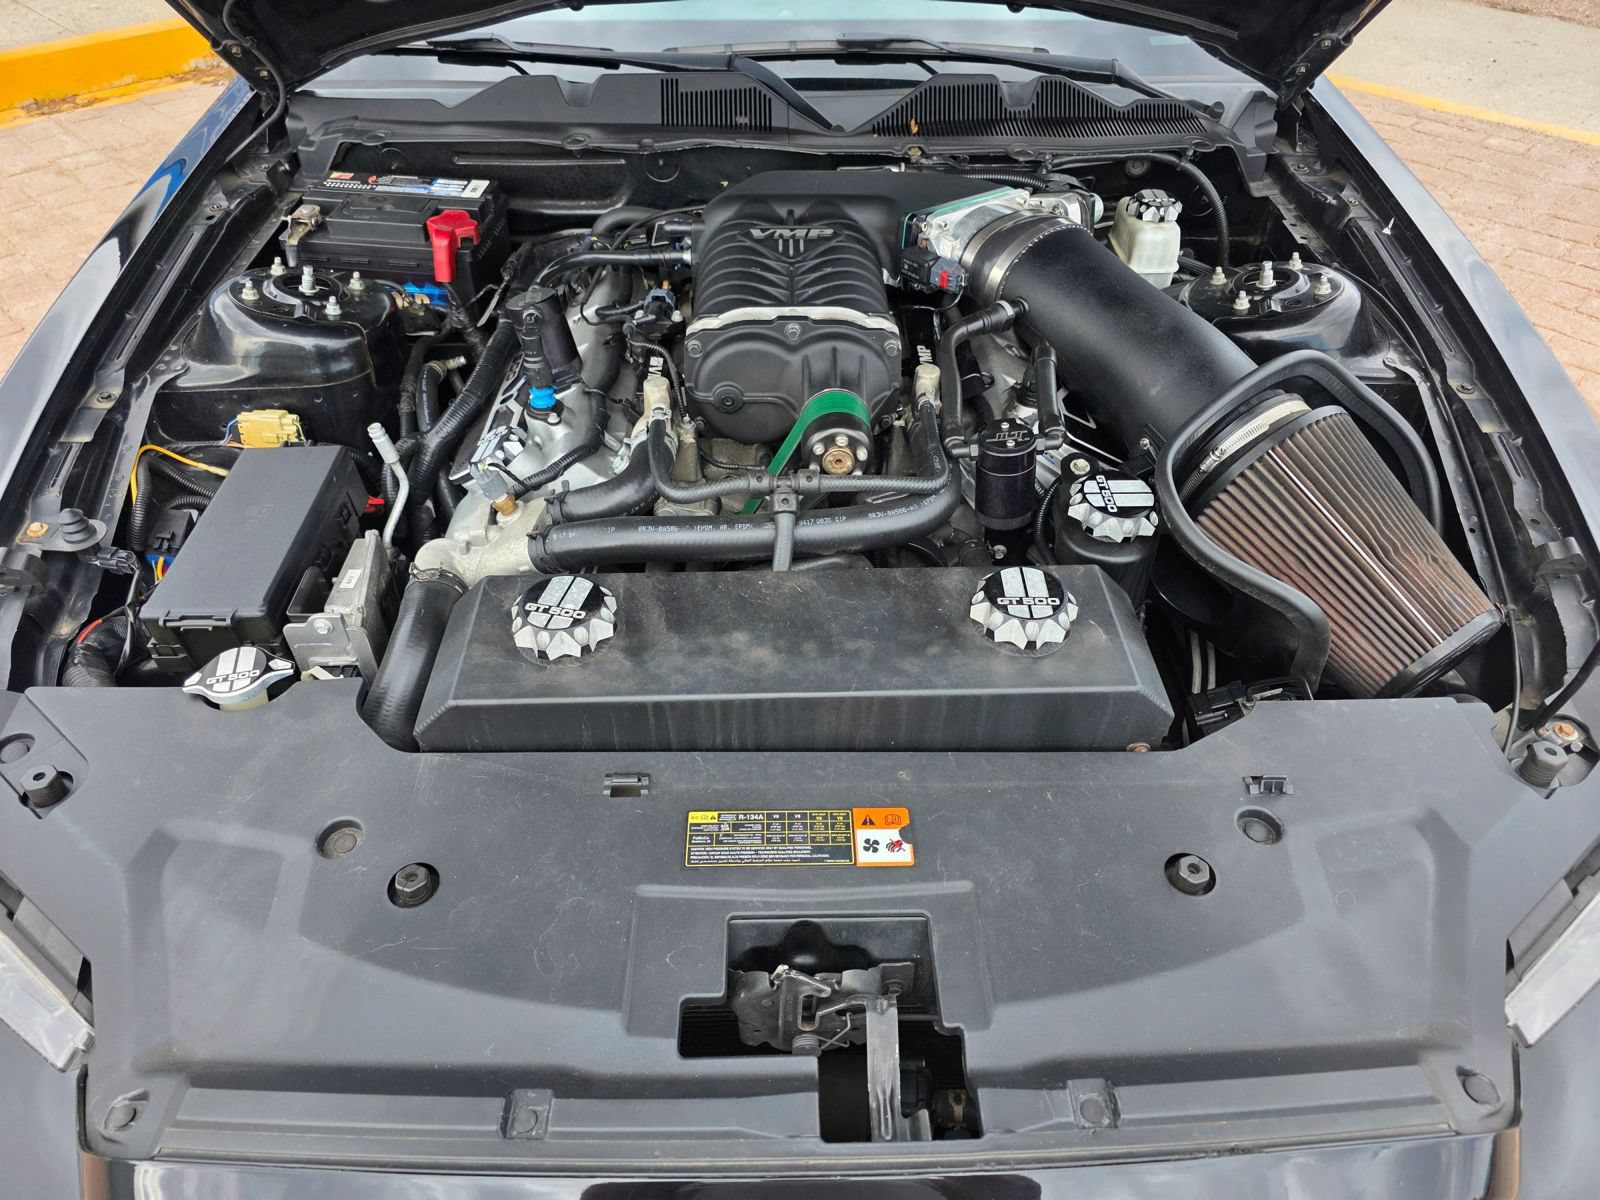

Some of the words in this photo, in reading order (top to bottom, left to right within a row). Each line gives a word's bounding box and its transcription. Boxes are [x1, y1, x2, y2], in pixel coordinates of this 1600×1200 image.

[750, 228, 834, 240] VMP
[1101, 490, 1118, 513] 500
[996, 597, 1020, 605] GT
[1022, 597, 1060, 606] 500
[524, 602, 549, 613] GT
[548, 606, 587, 620] 500
[206, 675, 227, 685] GT
[228, 669, 260, 681] 500
